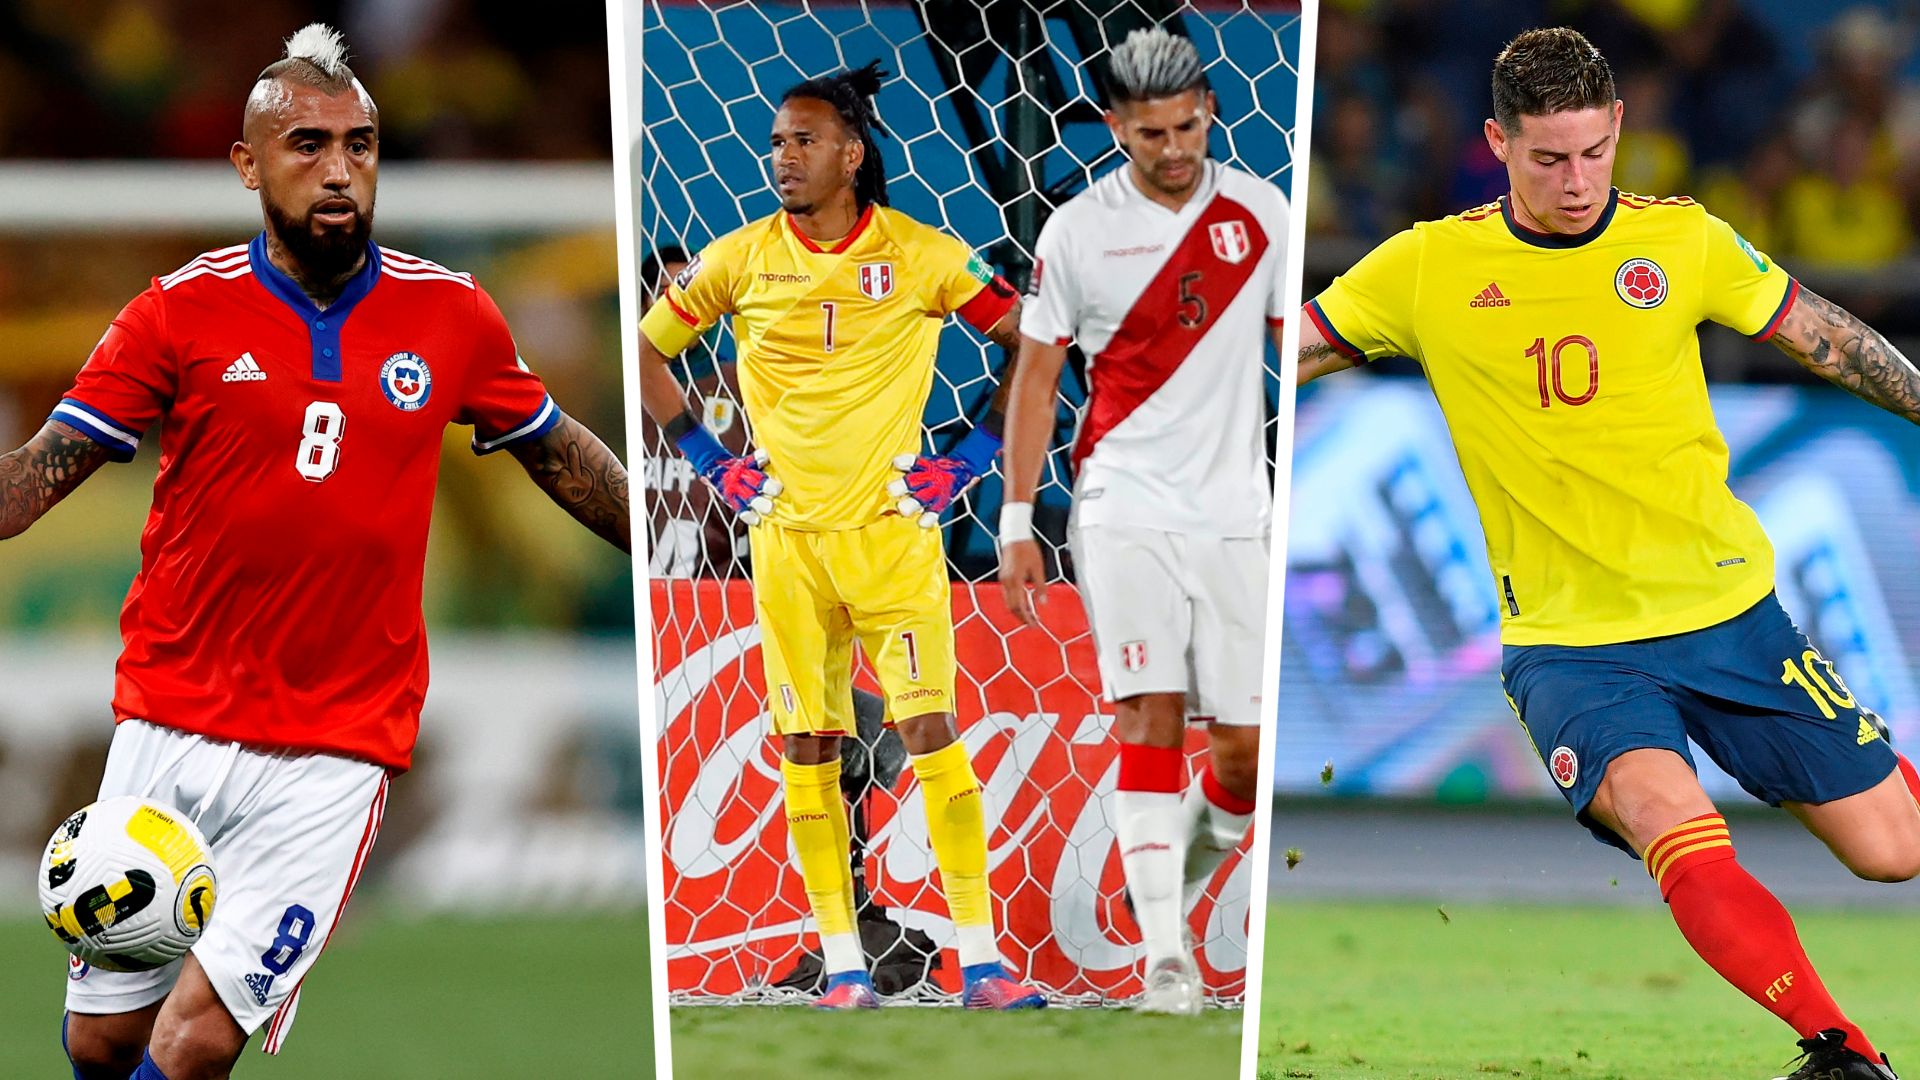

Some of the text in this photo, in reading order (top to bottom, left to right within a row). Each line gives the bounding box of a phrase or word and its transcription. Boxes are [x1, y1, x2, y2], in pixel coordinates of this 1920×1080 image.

[758, 272, 811, 284] marathon
[1177, 271, 1208, 329] 5
[1469, 298, 1511, 308] adidas
[821, 302, 835, 352] 1
[222, 370, 267, 382] adidas
[1524, 334, 1599, 408] 10
[295, 400, 346, 483] 8
[900, 631, 920, 681] 1
[895, 688, 944, 703] marathon
[1781, 650, 1856, 720] 10
[261, 903, 316, 978] 8
[244, 973, 268, 1006] adidas
[1765, 970, 1795, 1003] FCF
